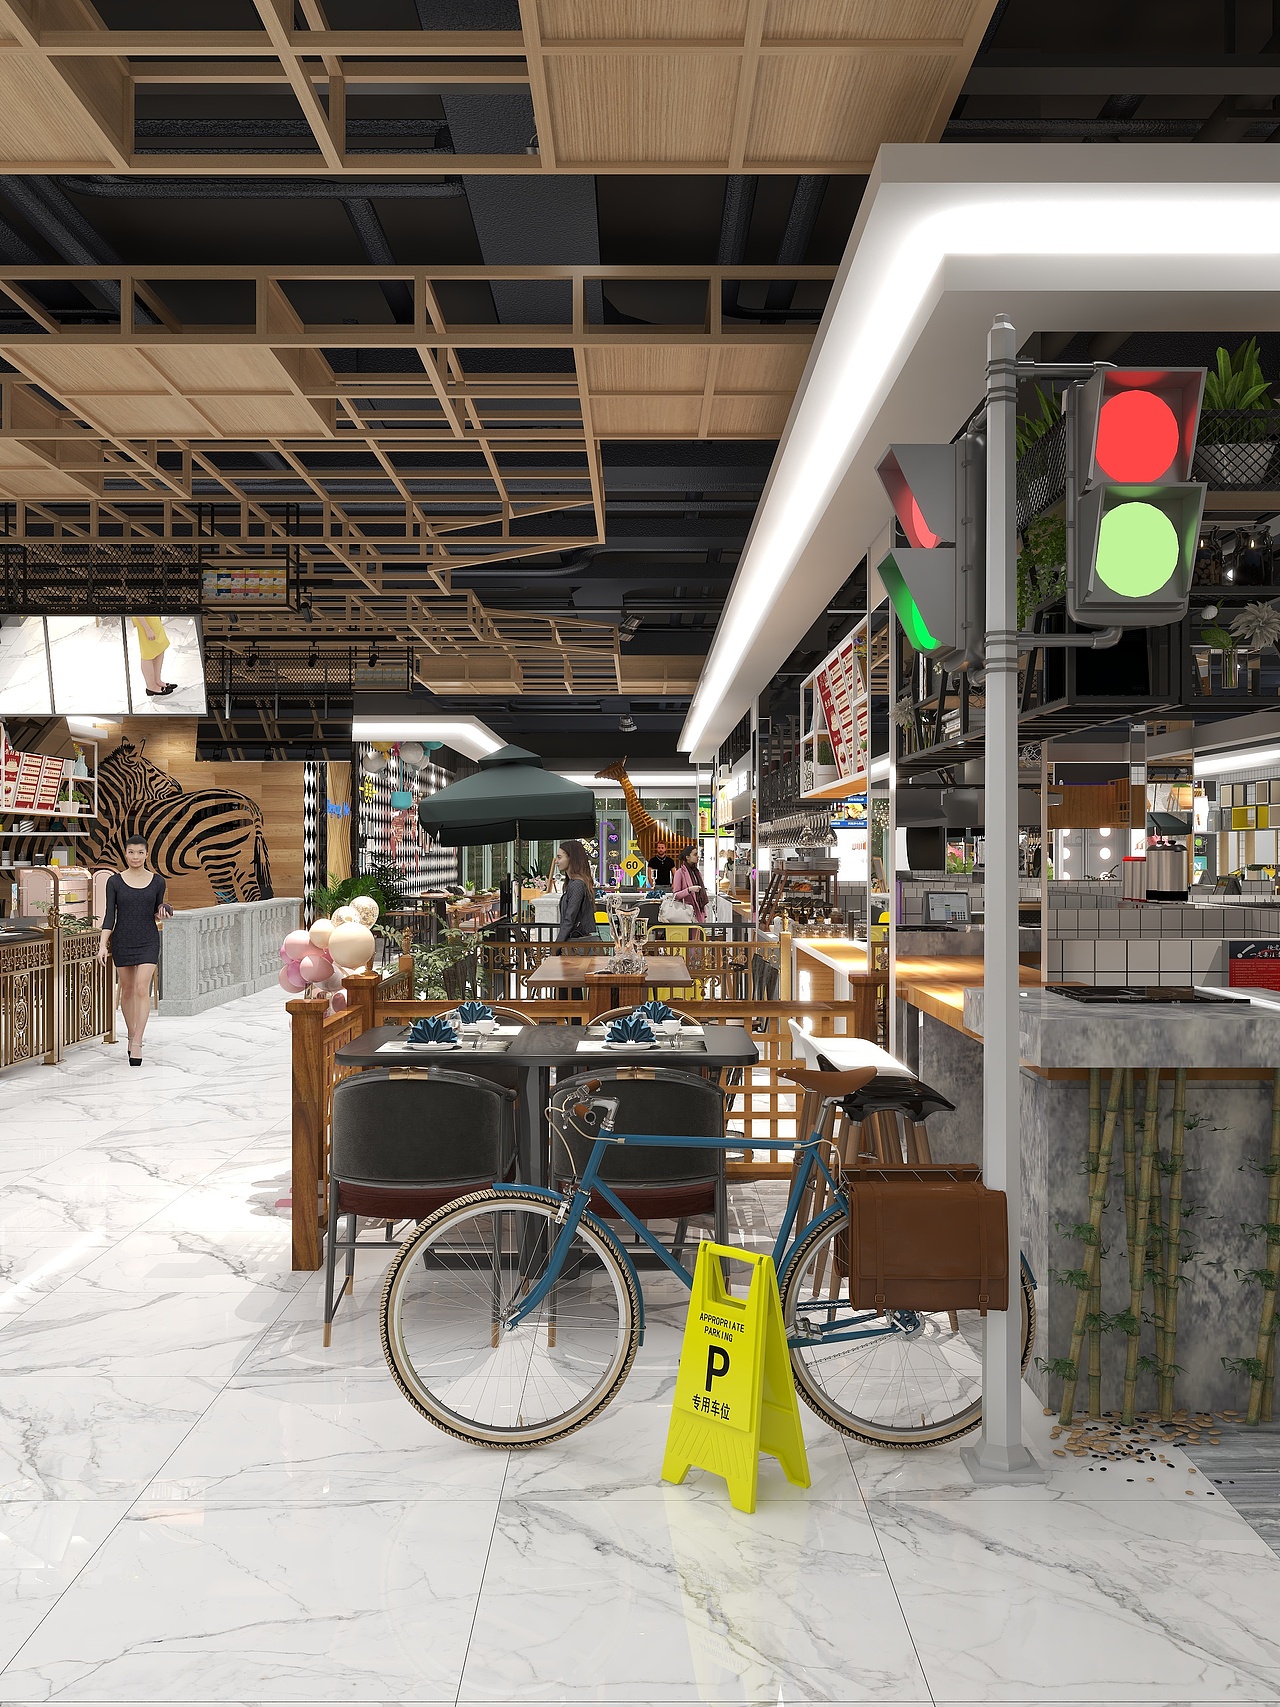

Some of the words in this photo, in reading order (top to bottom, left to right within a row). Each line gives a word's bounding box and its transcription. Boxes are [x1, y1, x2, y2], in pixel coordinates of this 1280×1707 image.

[626, 861, 638, 869] 60
[699, 1312, 745, 1333] APPROPRIATE
[704, 1326, 733, 1342] PARKING
[705, 1345, 730, 1392] P
[692, 1394, 730, 1420] 专用车位
